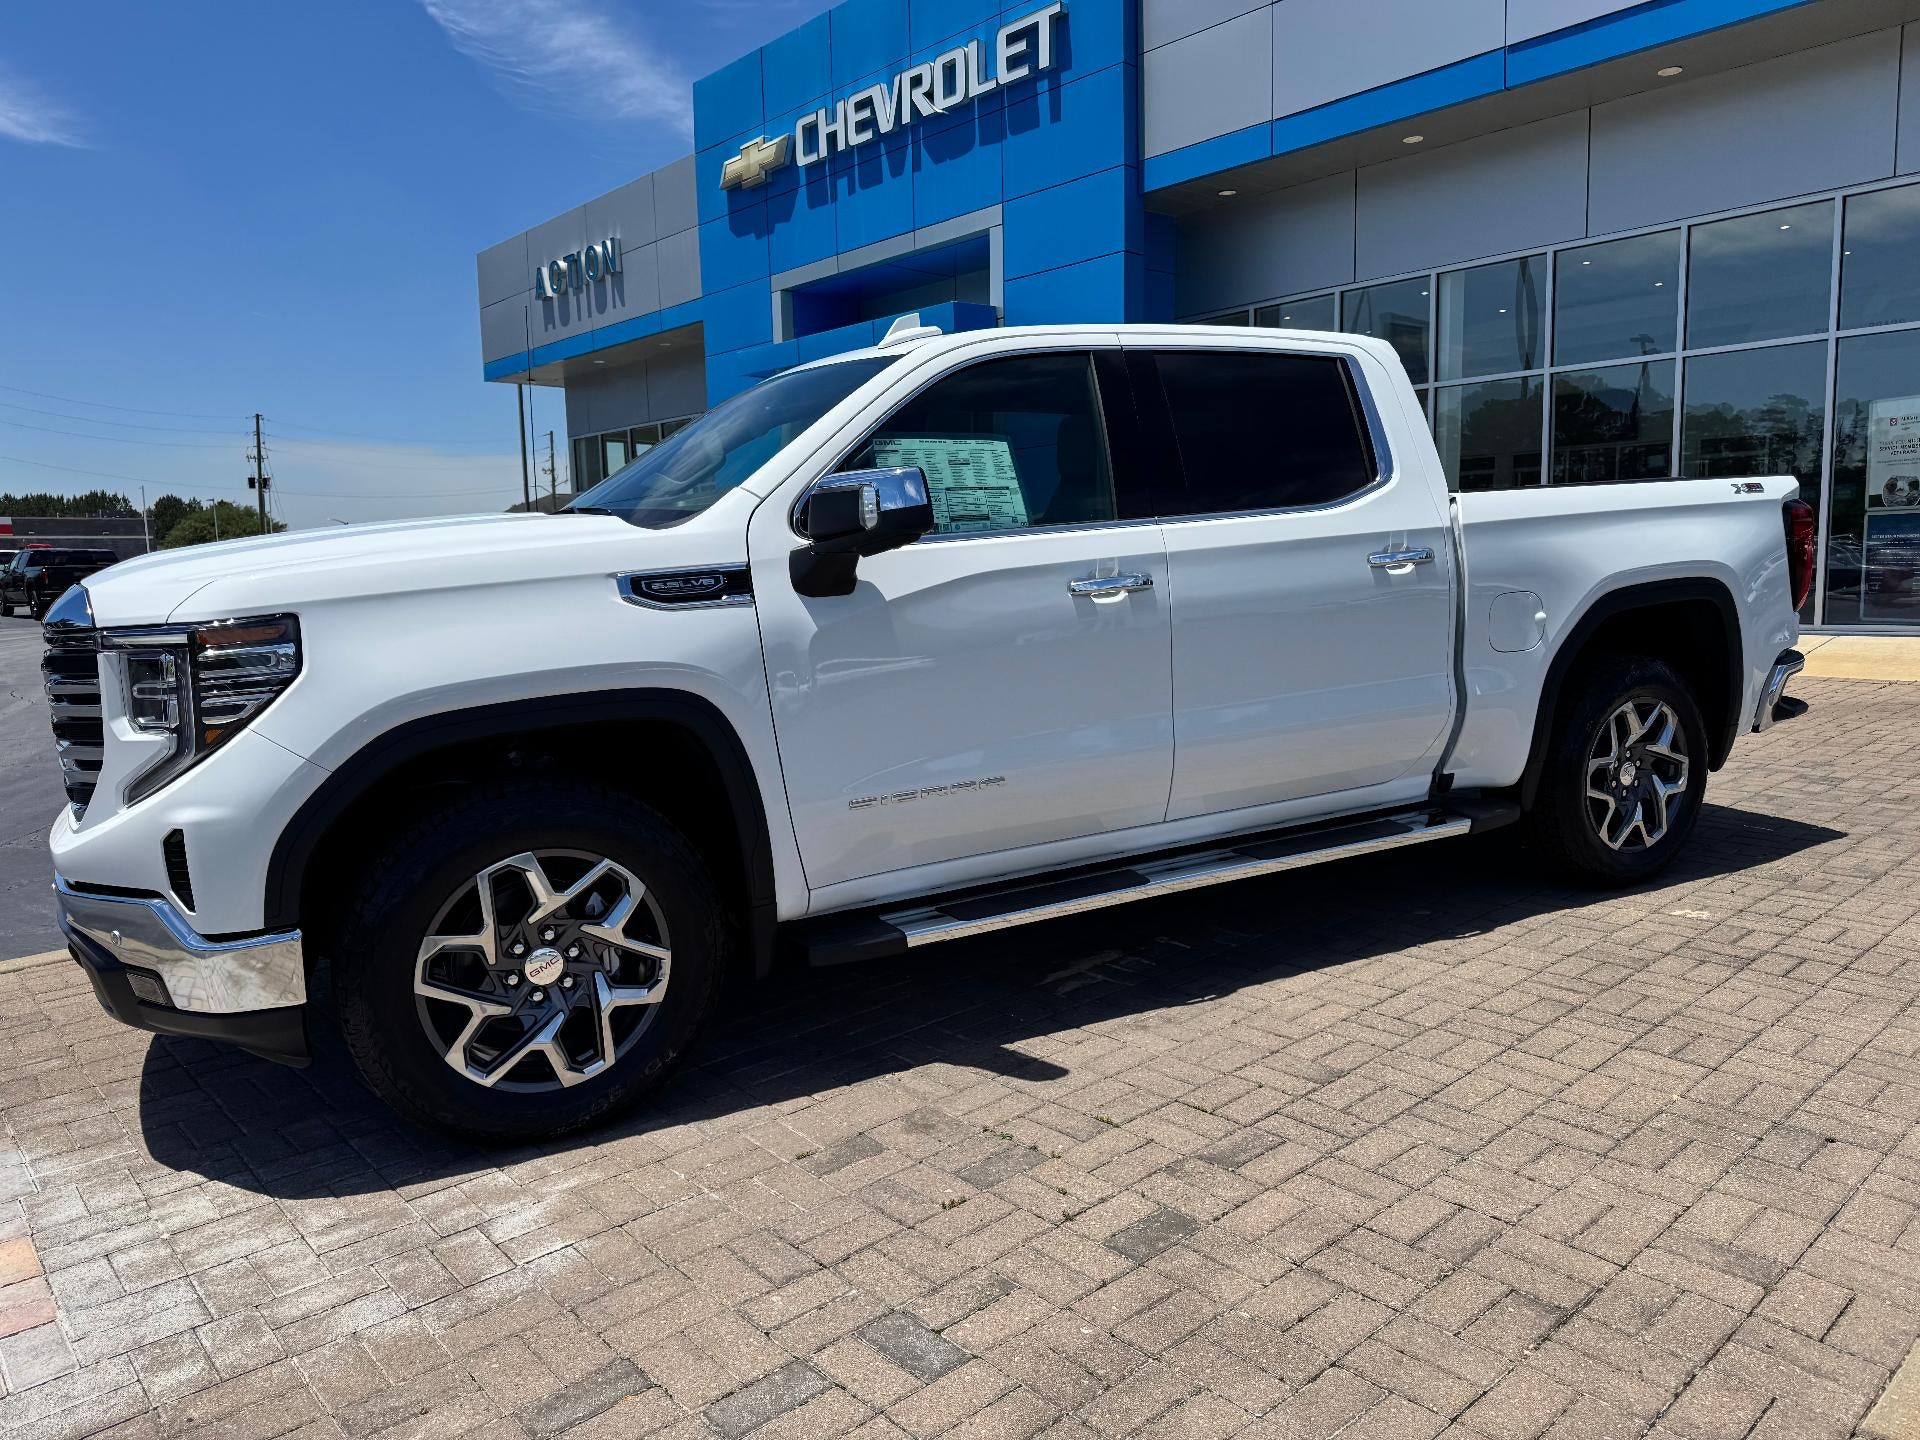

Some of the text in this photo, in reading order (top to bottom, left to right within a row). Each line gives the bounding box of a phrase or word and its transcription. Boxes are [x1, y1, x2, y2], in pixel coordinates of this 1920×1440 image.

[796, 1, 1065, 166] CHEVROLET
[535, 237, 621, 300] ACTION
[529, 956, 560, 977] GMC
